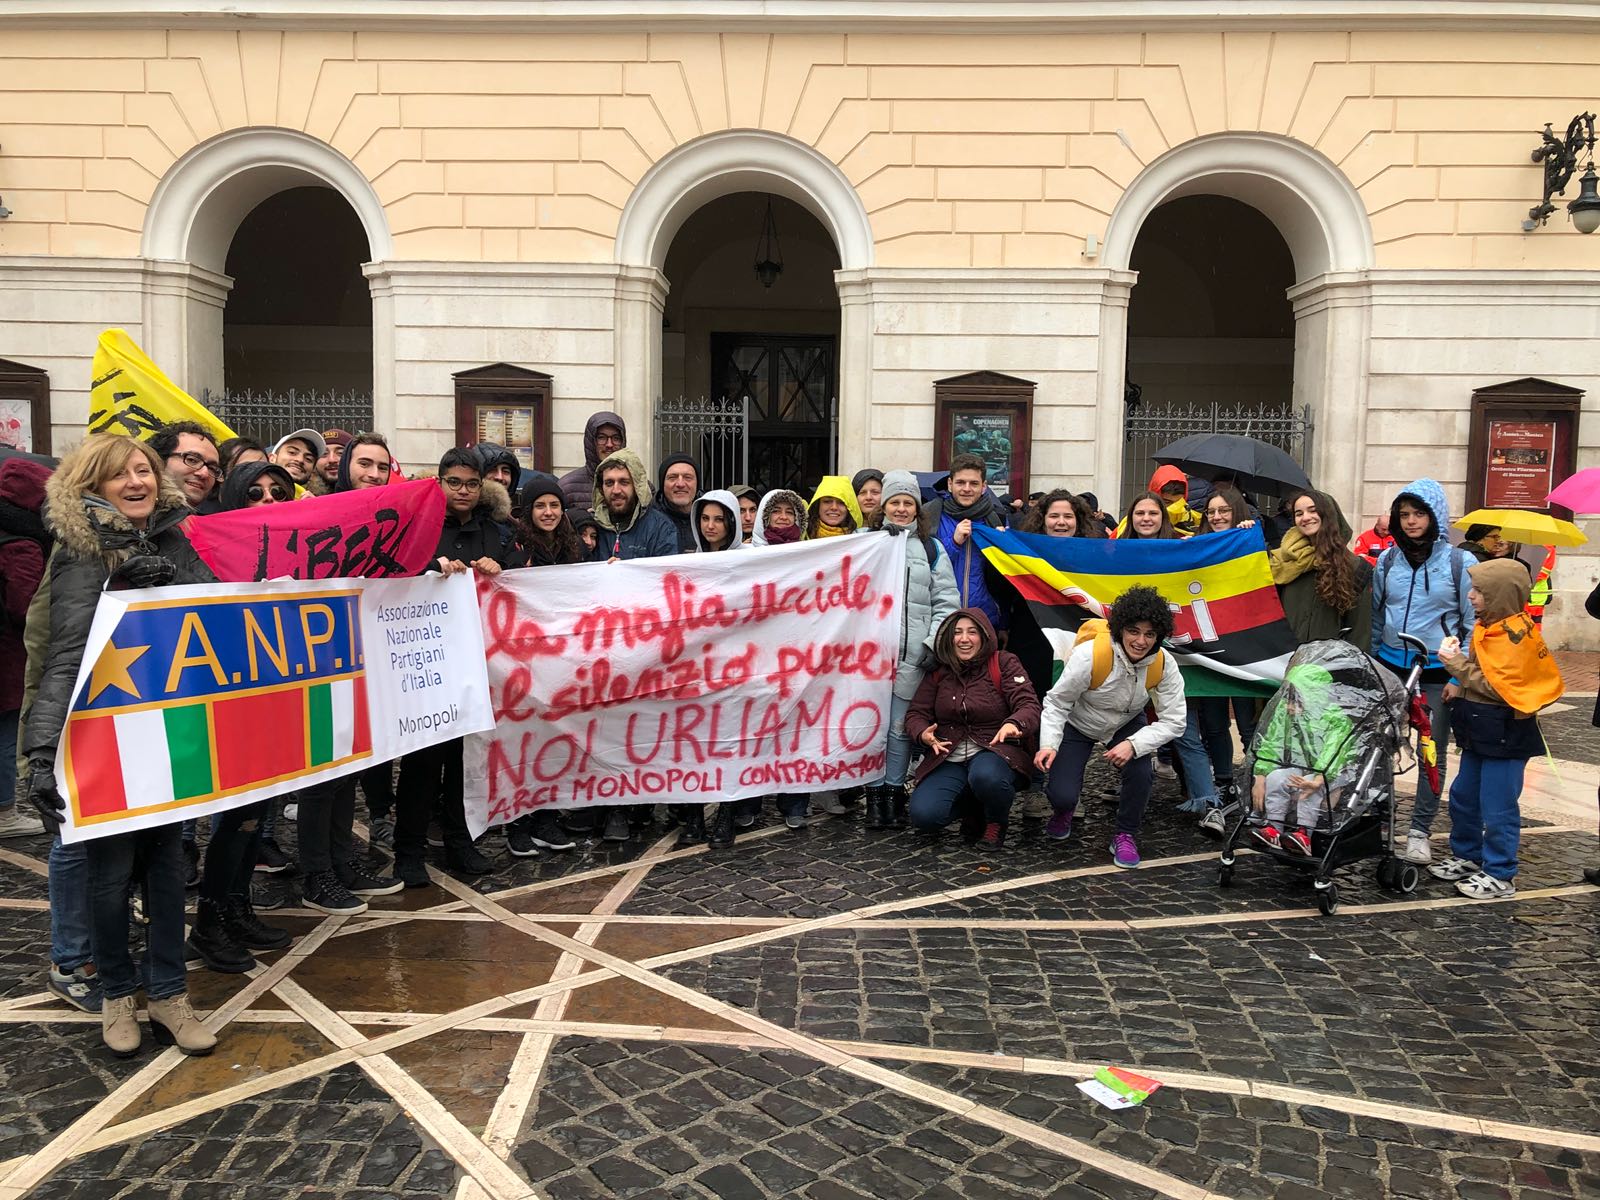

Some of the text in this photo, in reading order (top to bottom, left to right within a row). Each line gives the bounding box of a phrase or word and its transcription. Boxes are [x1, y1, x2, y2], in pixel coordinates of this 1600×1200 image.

[377, 601, 449, 623] Associazione
[386, 622, 442, 646] Nazionale
[573, 571, 738, 665] mafia
[390, 644, 446, 671] Partigiani
[539, 643, 760, 721] silenzio
[398, 703, 459, 737] Monopoli
[486, 687, 882, 804] NOI URLIAMO
[487, 785, 560, 824] ARCI
[571, 767, 723, 802] MONOPOLI
